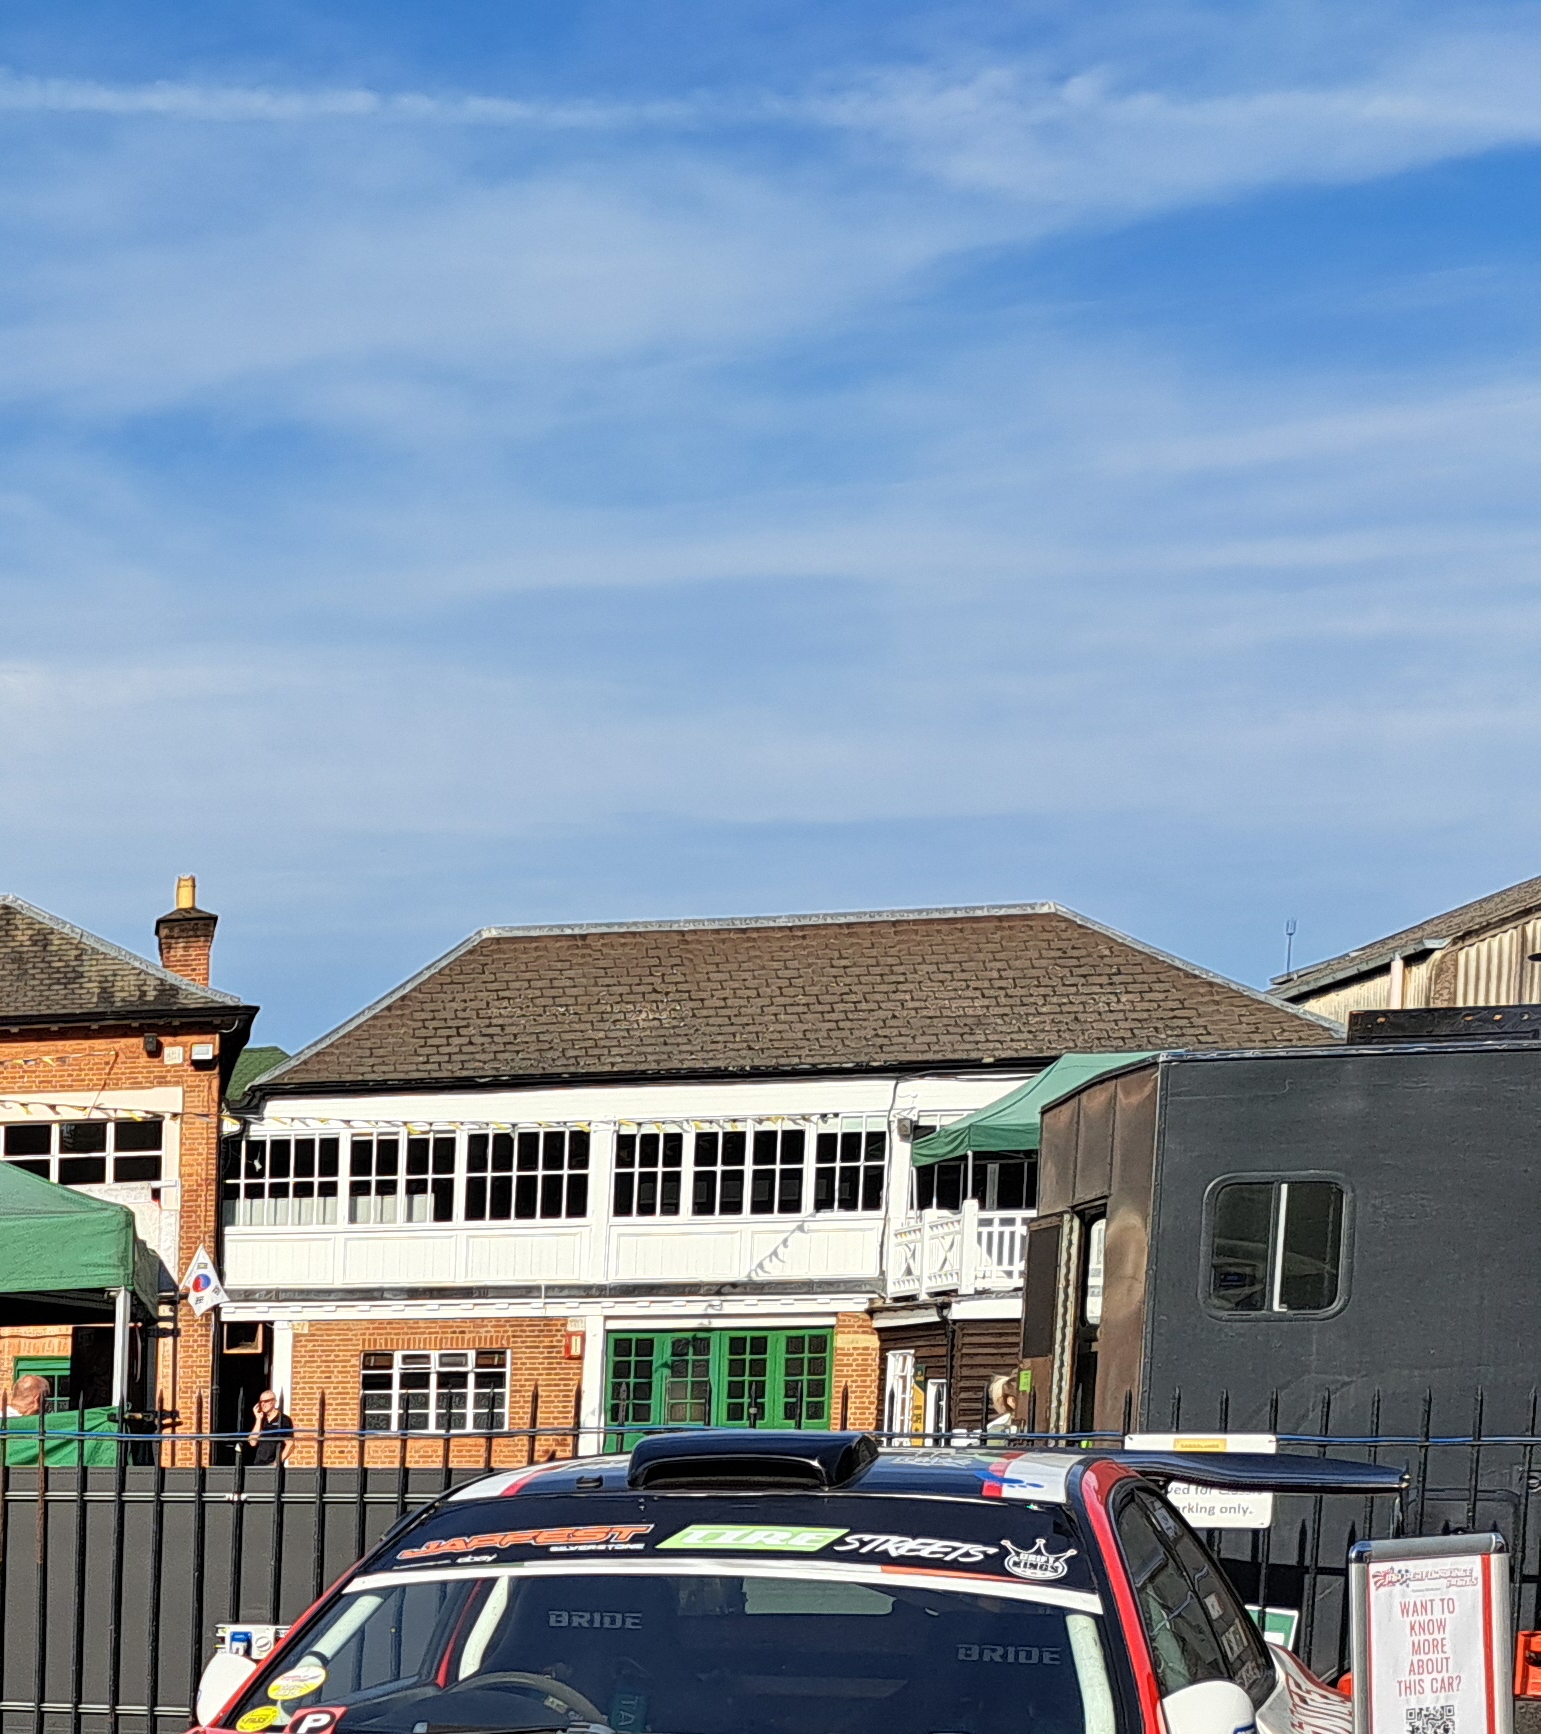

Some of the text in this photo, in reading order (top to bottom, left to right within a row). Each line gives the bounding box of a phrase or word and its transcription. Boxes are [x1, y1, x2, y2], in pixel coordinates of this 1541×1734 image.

[1219, 1503, 1254, 1517] only.
[679, 1528, 999, 1562] TIRE STREETS
[1400, 1598, 1455, 1619] WANT TO
[548, 1610, 643, 1630] BRIDE
[1409, 1618, 1447, 1637] KNOW
[956, 1643, 1062, 1666] BRIDE
[1411, 1637, 1447, 1656] MORE
[1408, 1656, 1450, 1676] ABOUT
[1397, 1675, 1461, 1697] THIS CAR?
